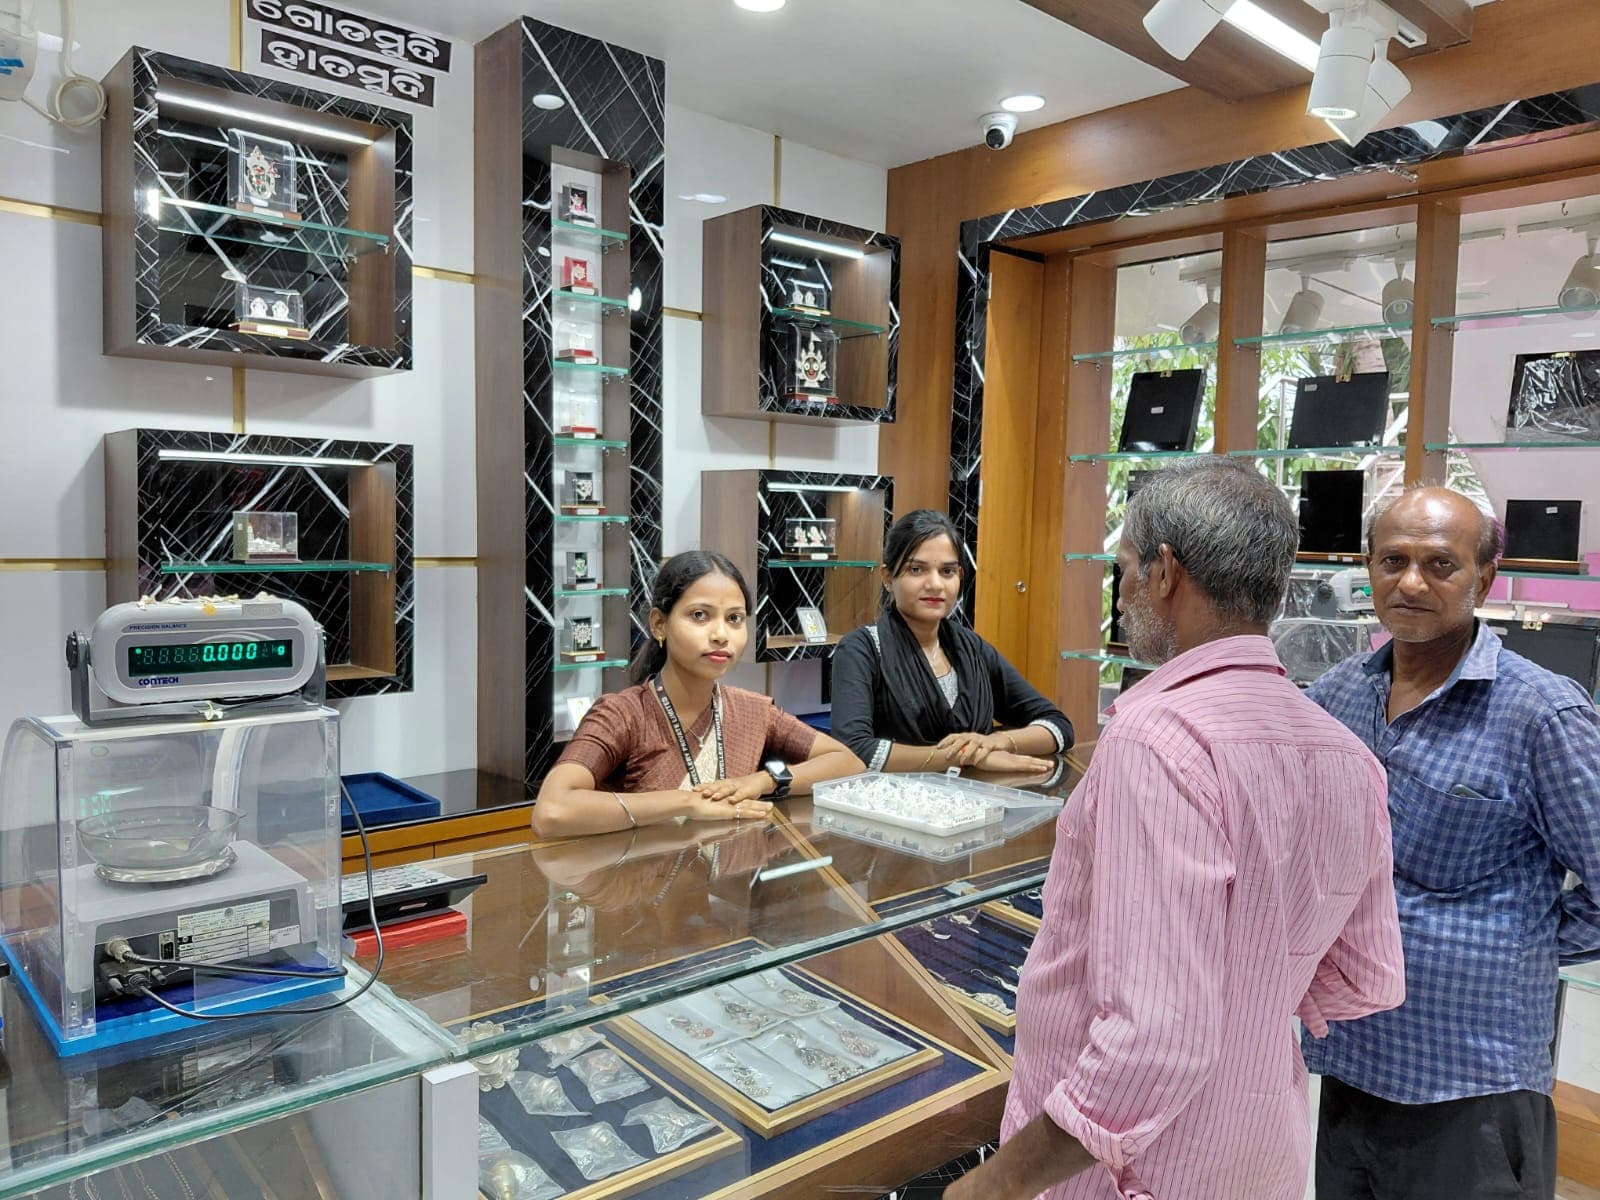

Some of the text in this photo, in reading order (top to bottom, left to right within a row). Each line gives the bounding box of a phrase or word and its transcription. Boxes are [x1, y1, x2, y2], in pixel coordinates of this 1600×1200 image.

[267, 41, 425, 98] ହାତମୁଦି
[203, 643, 257, 662] 0.000
[661, 696, 678, 724] LIMITED
[673, 723, 688, 751] PRIVATE
